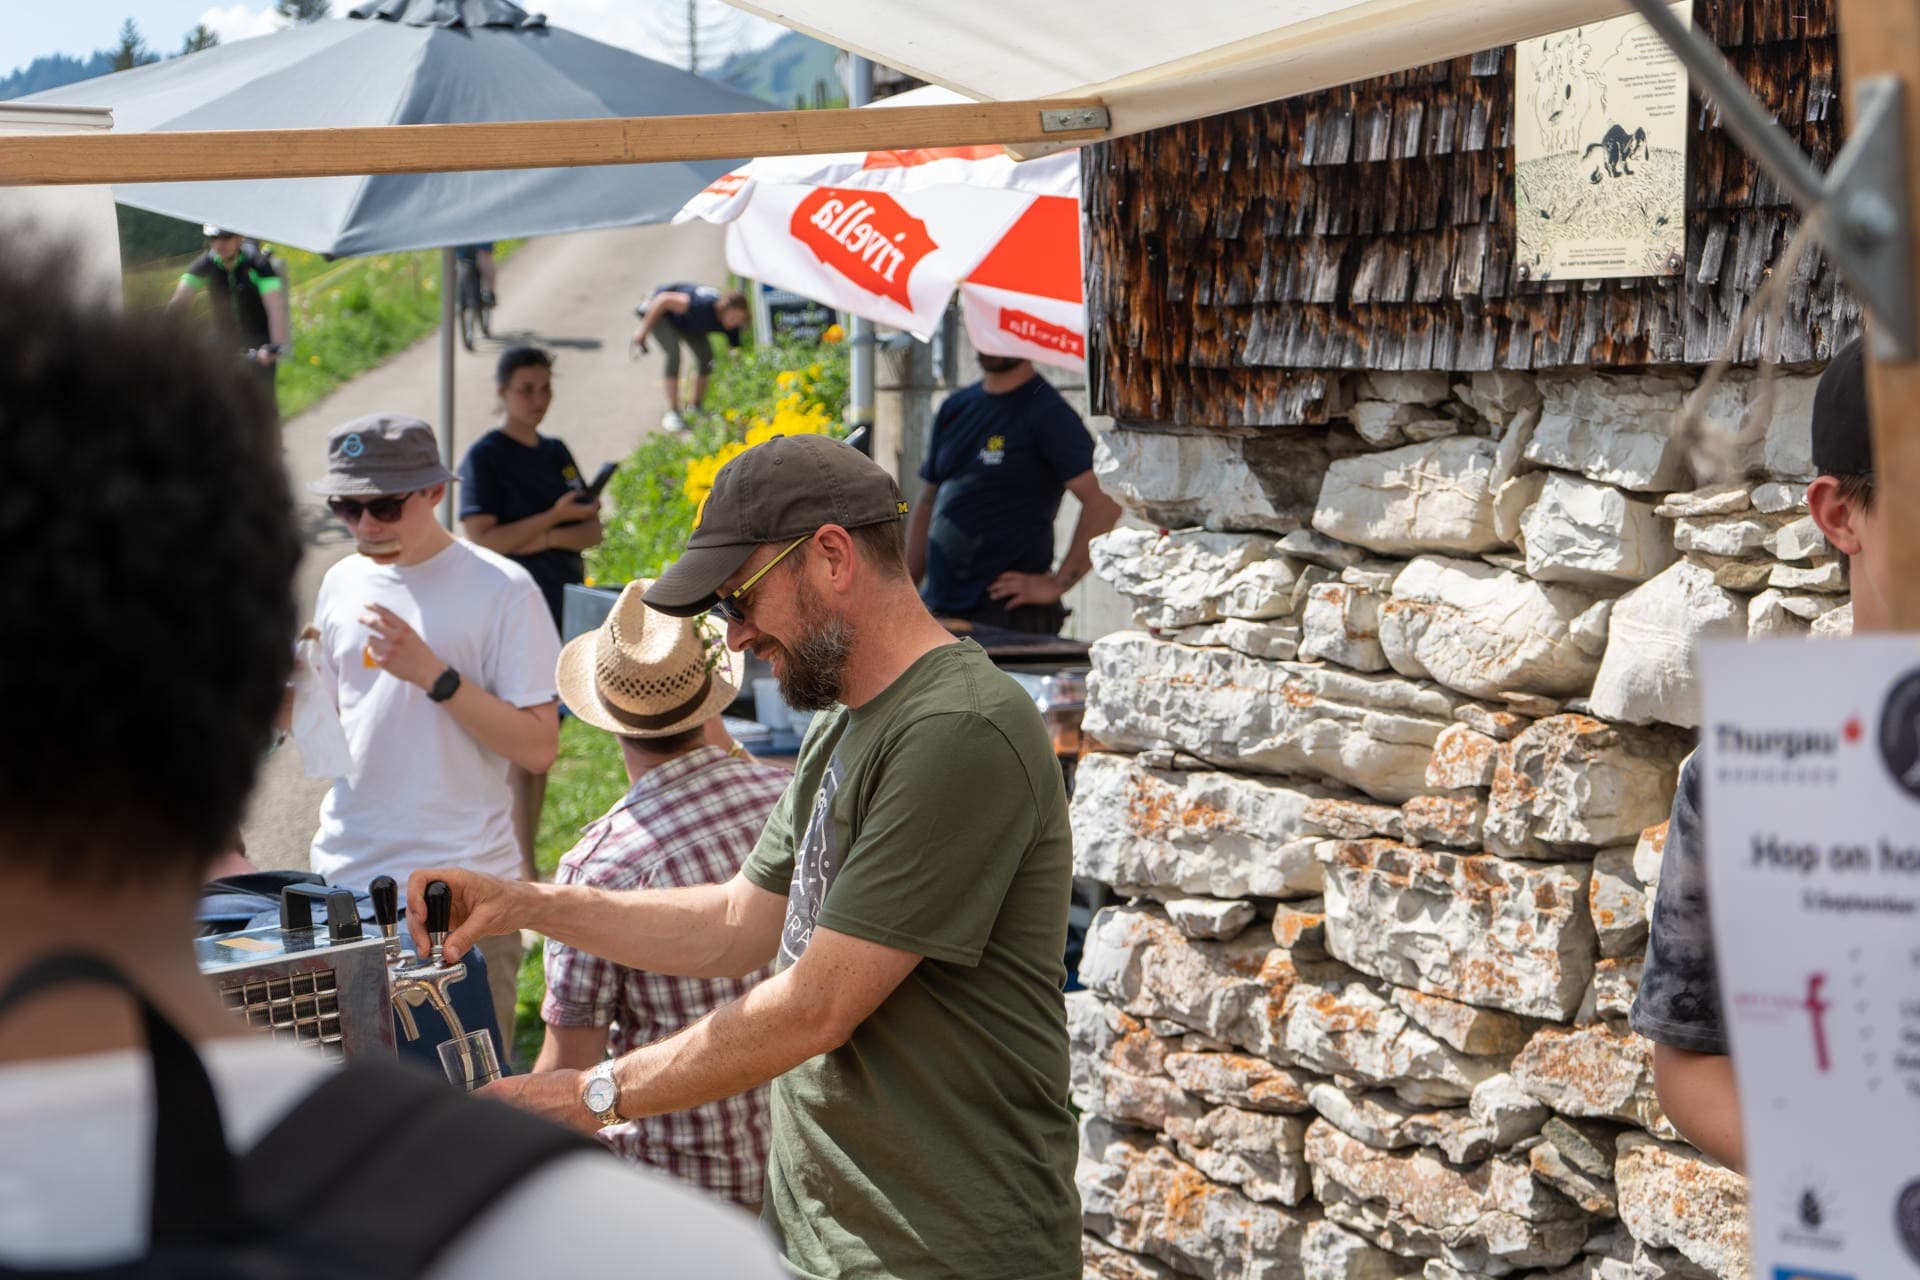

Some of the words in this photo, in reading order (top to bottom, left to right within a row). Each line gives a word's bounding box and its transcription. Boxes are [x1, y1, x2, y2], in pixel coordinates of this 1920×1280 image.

[1715, 722, 1837, 757] Thurgau
[1751, 835, 1819, 875] Hop
[1829, 843, 1871, 872] on
